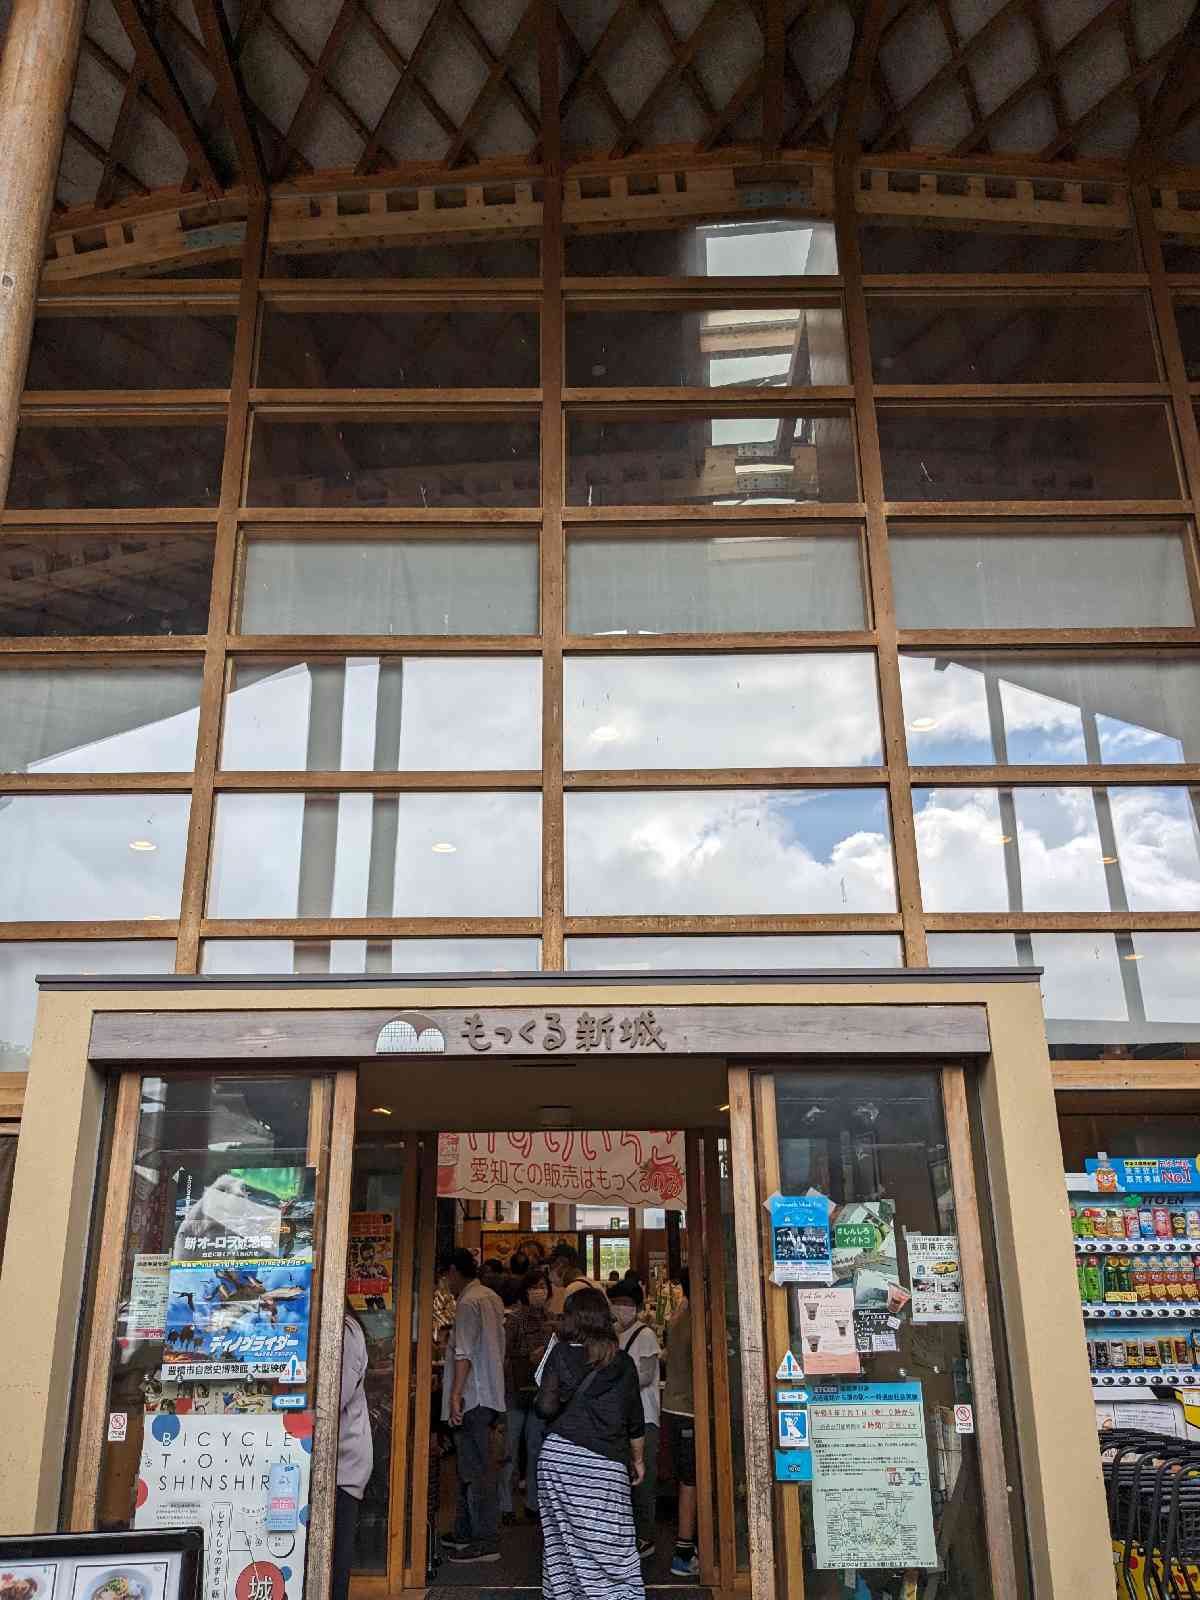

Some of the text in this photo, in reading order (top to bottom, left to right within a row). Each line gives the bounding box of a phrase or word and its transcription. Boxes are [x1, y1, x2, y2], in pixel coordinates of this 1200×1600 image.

[461, 1011, 668, 1052] もっくる新城
[210, 1335, 299, 1352] ディノグライダー
[168, 1364, 249, 1376] 豊橋市自然史博物館
[162, 1431, 295, 1449] BICYCLE
[159, 1474, 271, 1492] SHINSHIR
